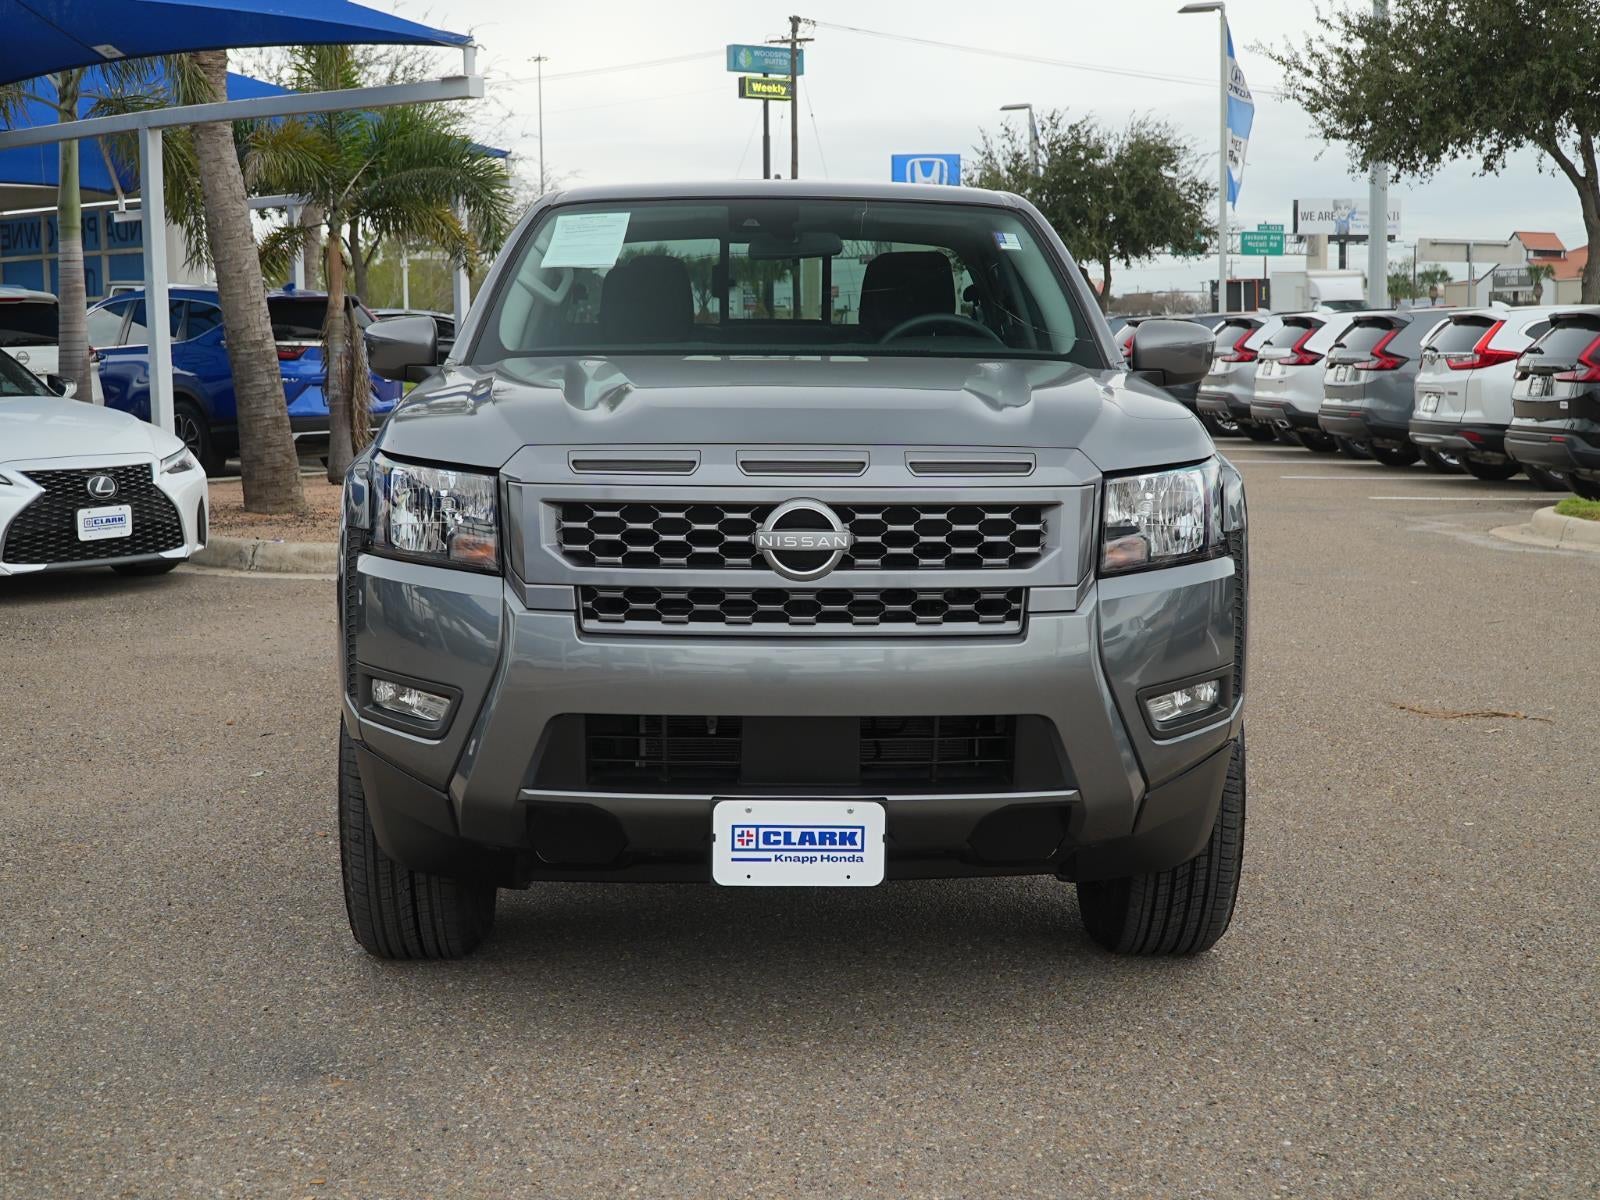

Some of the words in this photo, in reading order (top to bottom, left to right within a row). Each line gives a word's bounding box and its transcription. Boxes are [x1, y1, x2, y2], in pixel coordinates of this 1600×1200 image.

[753, 49, 799, 59] WOODSPR
[752, 82, 787, 95] Weekly
[1228, 83, 1251, 100] ONDA
[1300, 211, 1315, 221] WE
[1317, 211, 1335, 221] ARE
[93, 516, 124, 525] CLARK
[759, 535, 848, 547] NISSAN
[762, 830, 858, 846] CLARK
[774, 854, 818, 864] Knapp
[820, 854, 864, 863] Honda
